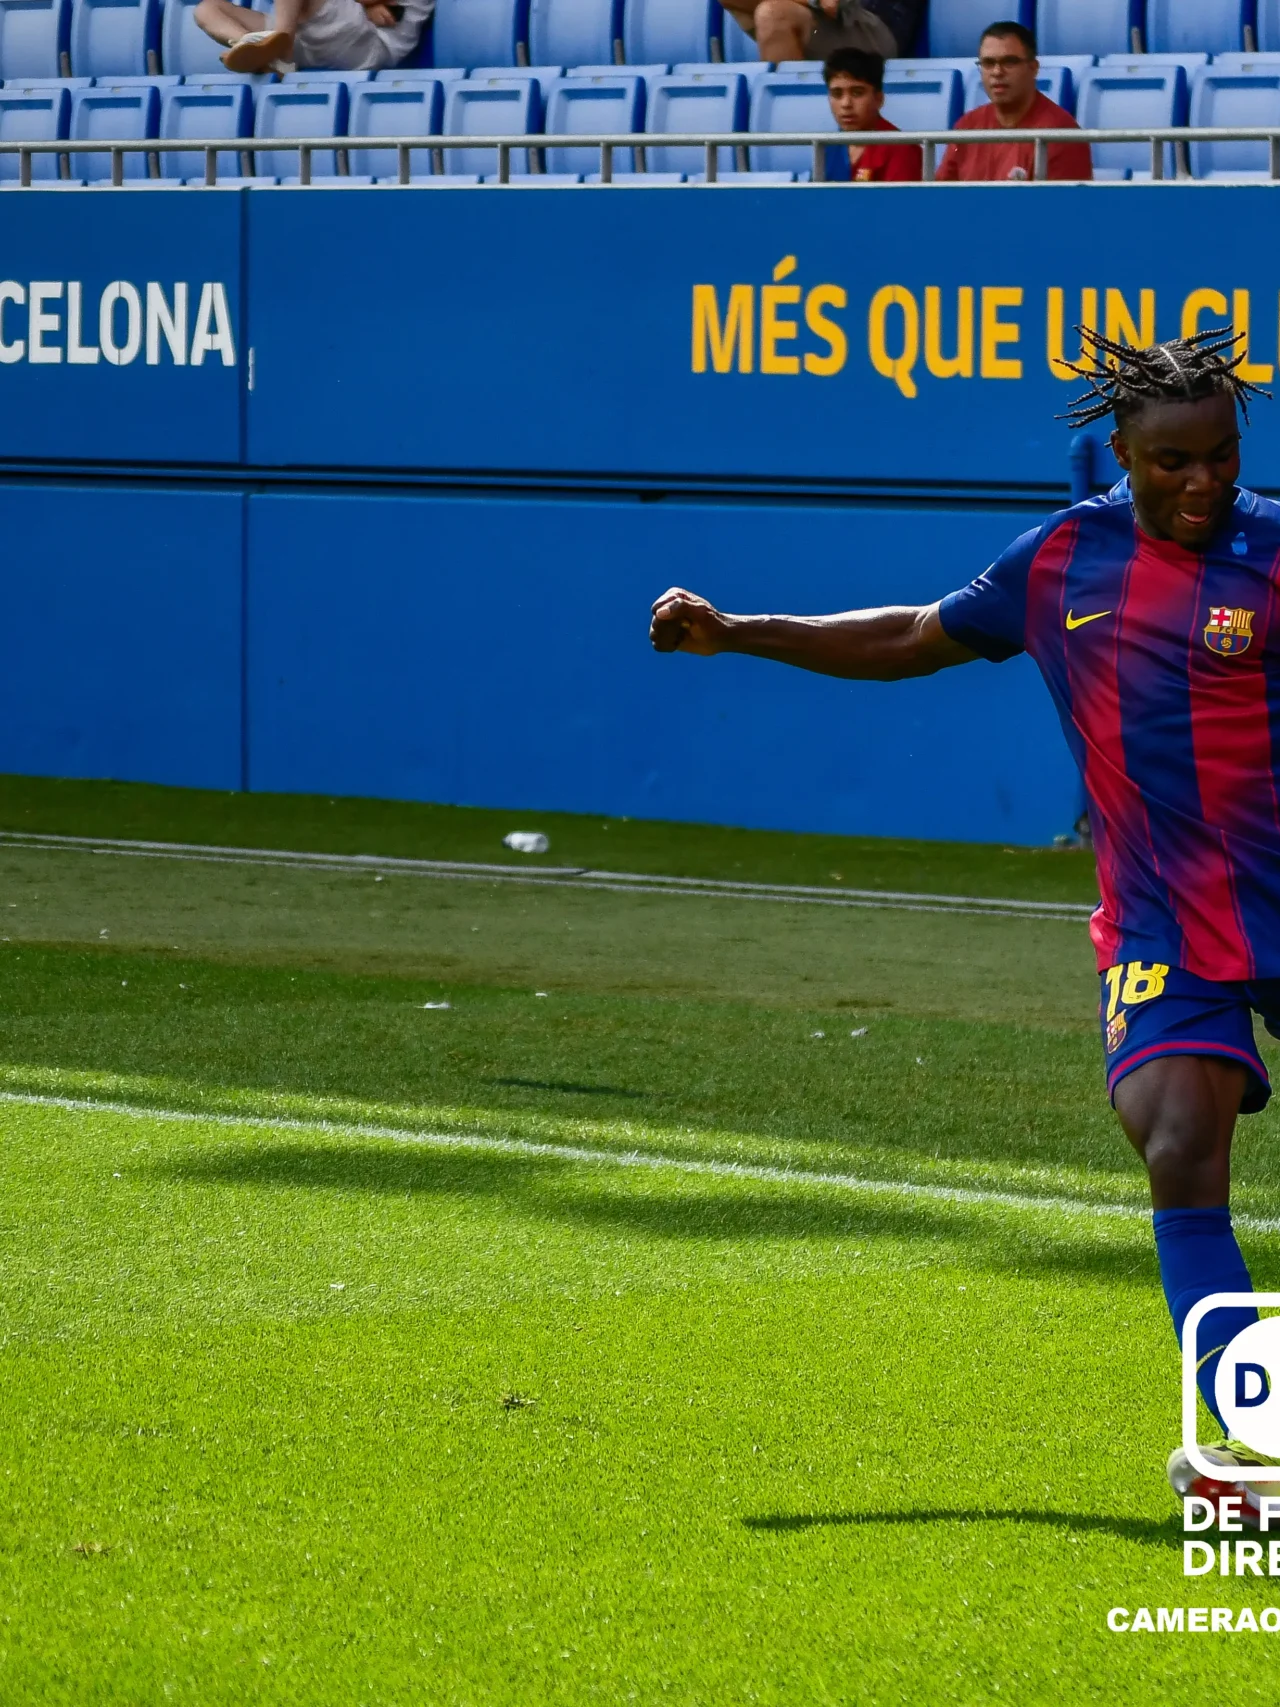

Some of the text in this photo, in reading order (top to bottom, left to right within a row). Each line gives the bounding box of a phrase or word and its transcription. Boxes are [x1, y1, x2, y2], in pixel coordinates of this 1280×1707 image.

[0, 280, 236, 366] CELONA
[692, 255, 847, 376] MÉS
[868, 285, 1024, 398] QUE
[1047, 287, 1156, 382] UN
[1106, 961, 1170, 1022] 18
